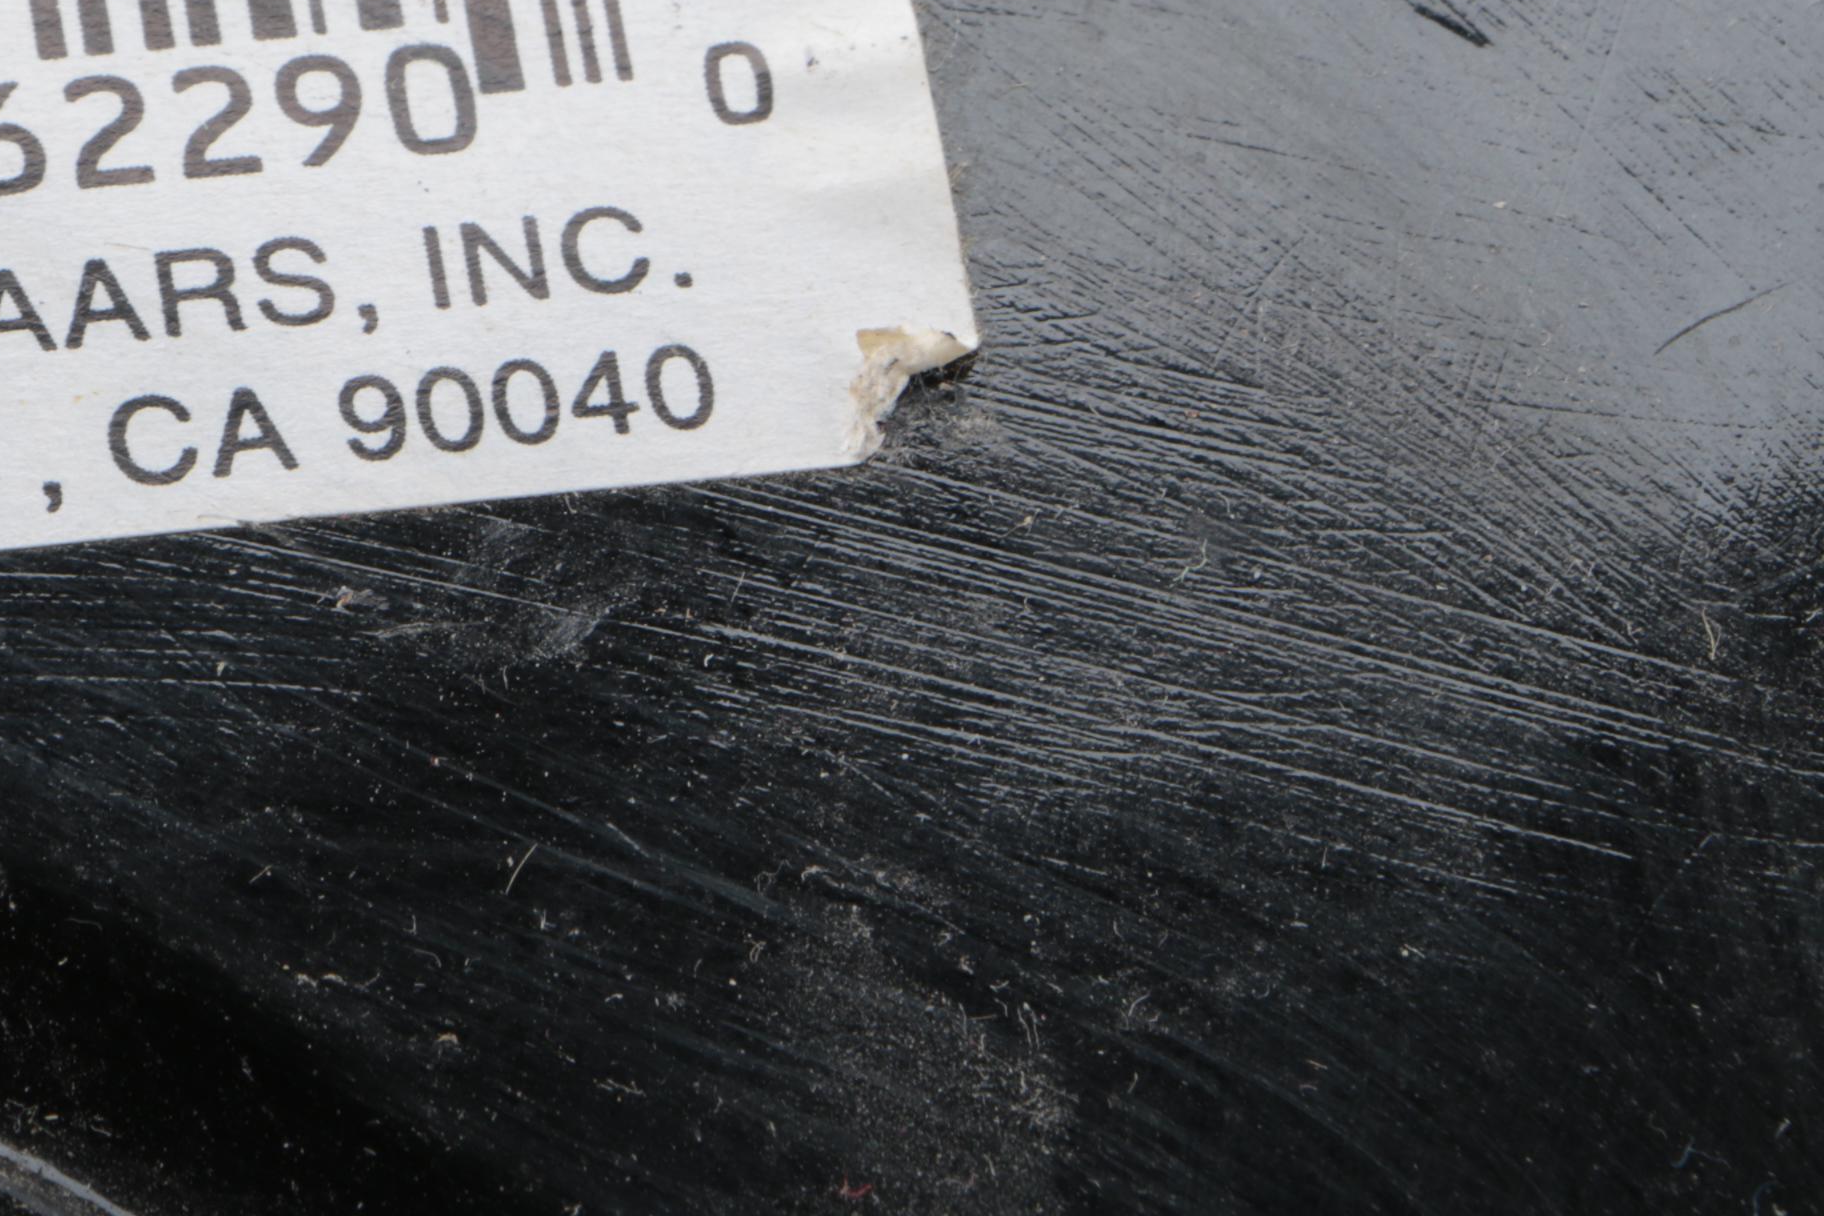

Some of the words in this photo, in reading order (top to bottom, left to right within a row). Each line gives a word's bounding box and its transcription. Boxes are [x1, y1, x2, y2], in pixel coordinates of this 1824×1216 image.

[703, 41, 776, 125] 0
[422, 205, 694, 311] INC.
[108, 386, 300, 486] CA
[337, 343, 716, 462] 90040
